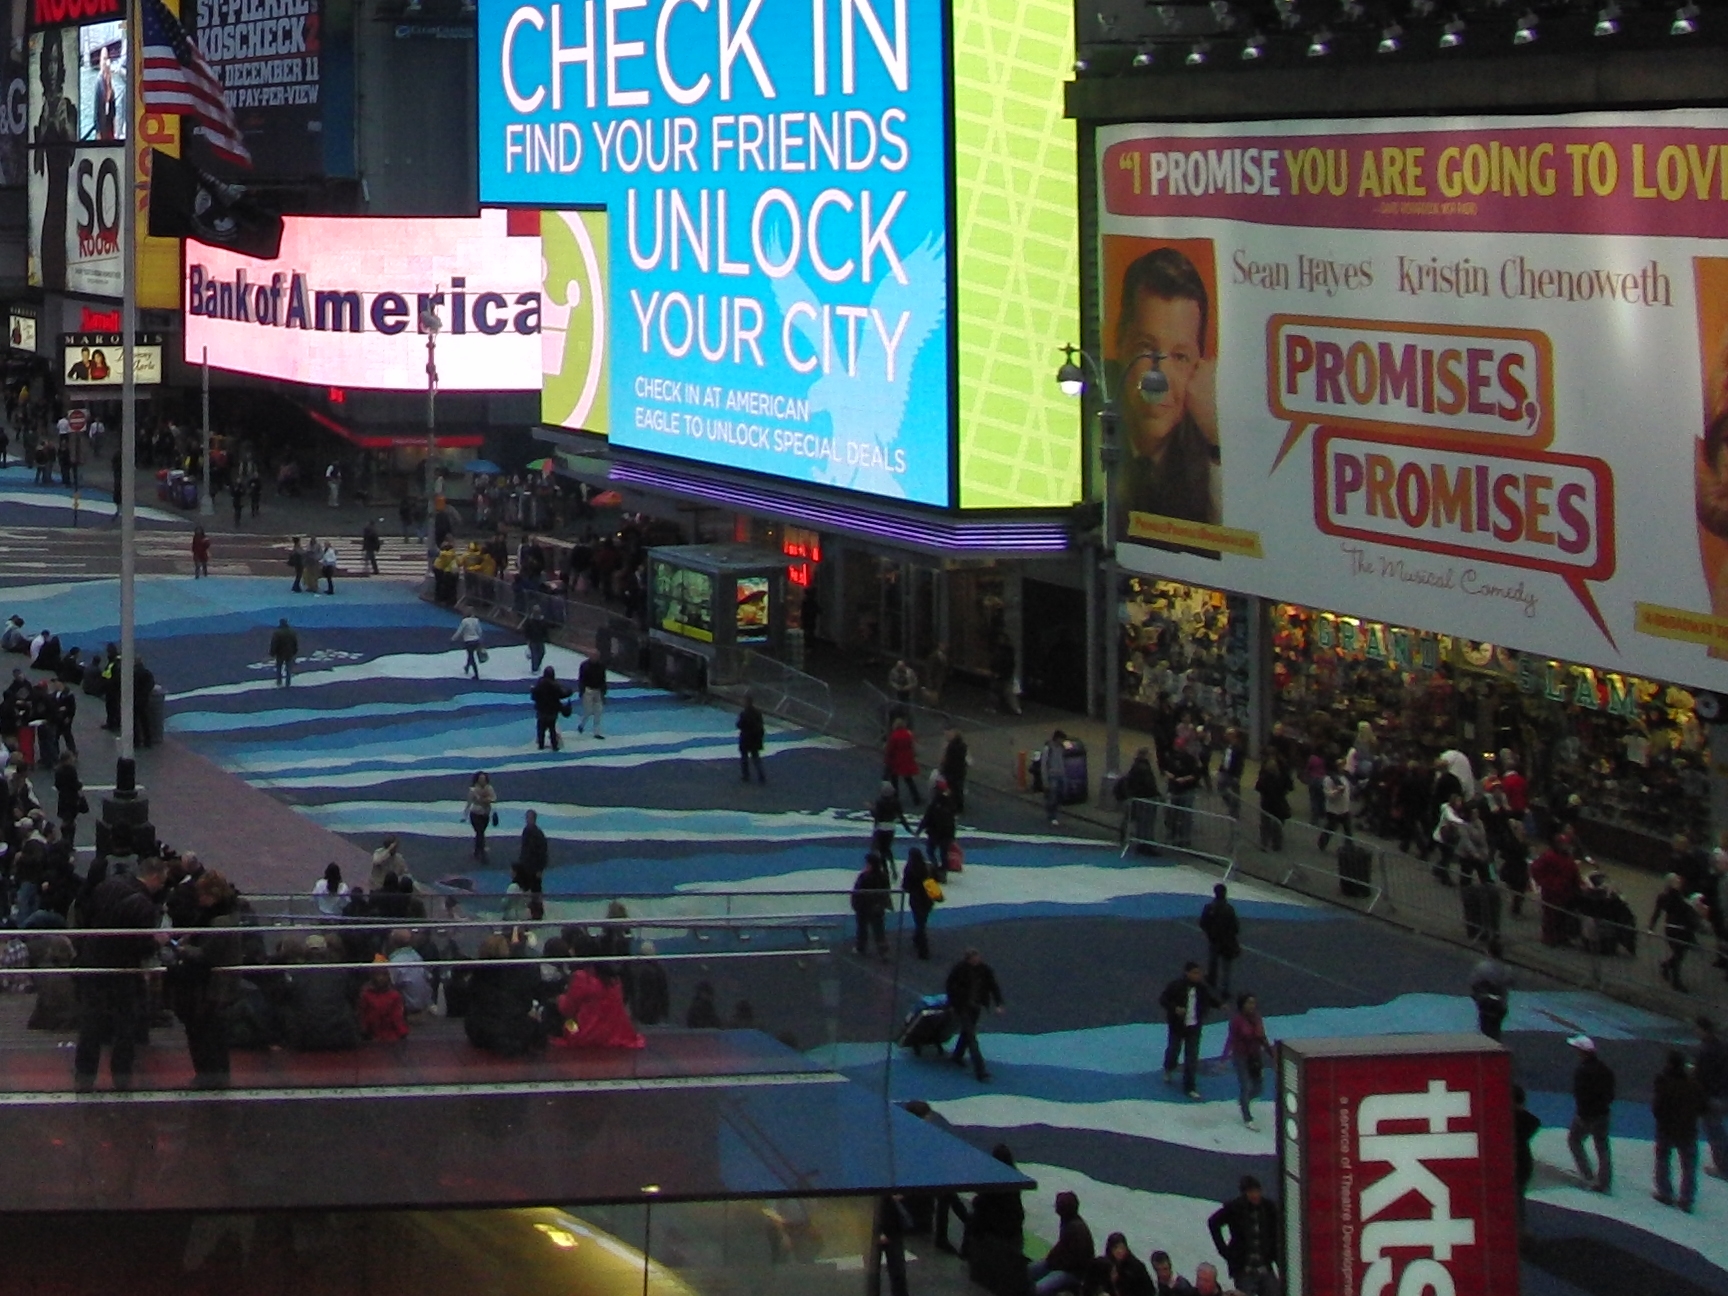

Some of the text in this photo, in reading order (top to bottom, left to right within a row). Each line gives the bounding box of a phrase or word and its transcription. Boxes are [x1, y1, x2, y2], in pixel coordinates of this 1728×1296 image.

[196, 14, 320, 61] KOSCHECK 2
[225, 59, 304, 87] DECEMBER
[305, 57, 320, 81] 11
[238, 84, 319, 107] PAY-PER-VIEW
[505, 108, 909, 174] FIND YOUR FRIENDS
[1149, 147, 1281, 197] PROMISE
[1283, 147, 1349, 196] YOU
[1358, 146, 1426, 196] ARE
[1437, 141, 1557, 197] GOING
[1564, 141, 1618, 196] TO
[77, 157, 120, 234] SO
[625, 188, 909, 285] UNLOCK
[189, 264, 541, 335] Bank of America
[1232, 249, 1674, 307] Sean Hayes Kristin Chenoweth
[65, 334, 163, 344] MARQIS
[630, 290, 911, 383] YOUR CITY
[634, 375, 809, 423] CHECK IN AT AMERICAN
[1284, 334, 1541, 431] PROMISES,
[634, 408, 906, 475] EAGLE TO UNLOCK SPECIAL DEALS
[1333, 448, 1592, 554] PROMISES
[1341, 541, 1540, 618] The Musical Comedy
[1339, 1108, 1353, 1221] service Theatre
[1357, 1080, 1479, 1296] tkts
